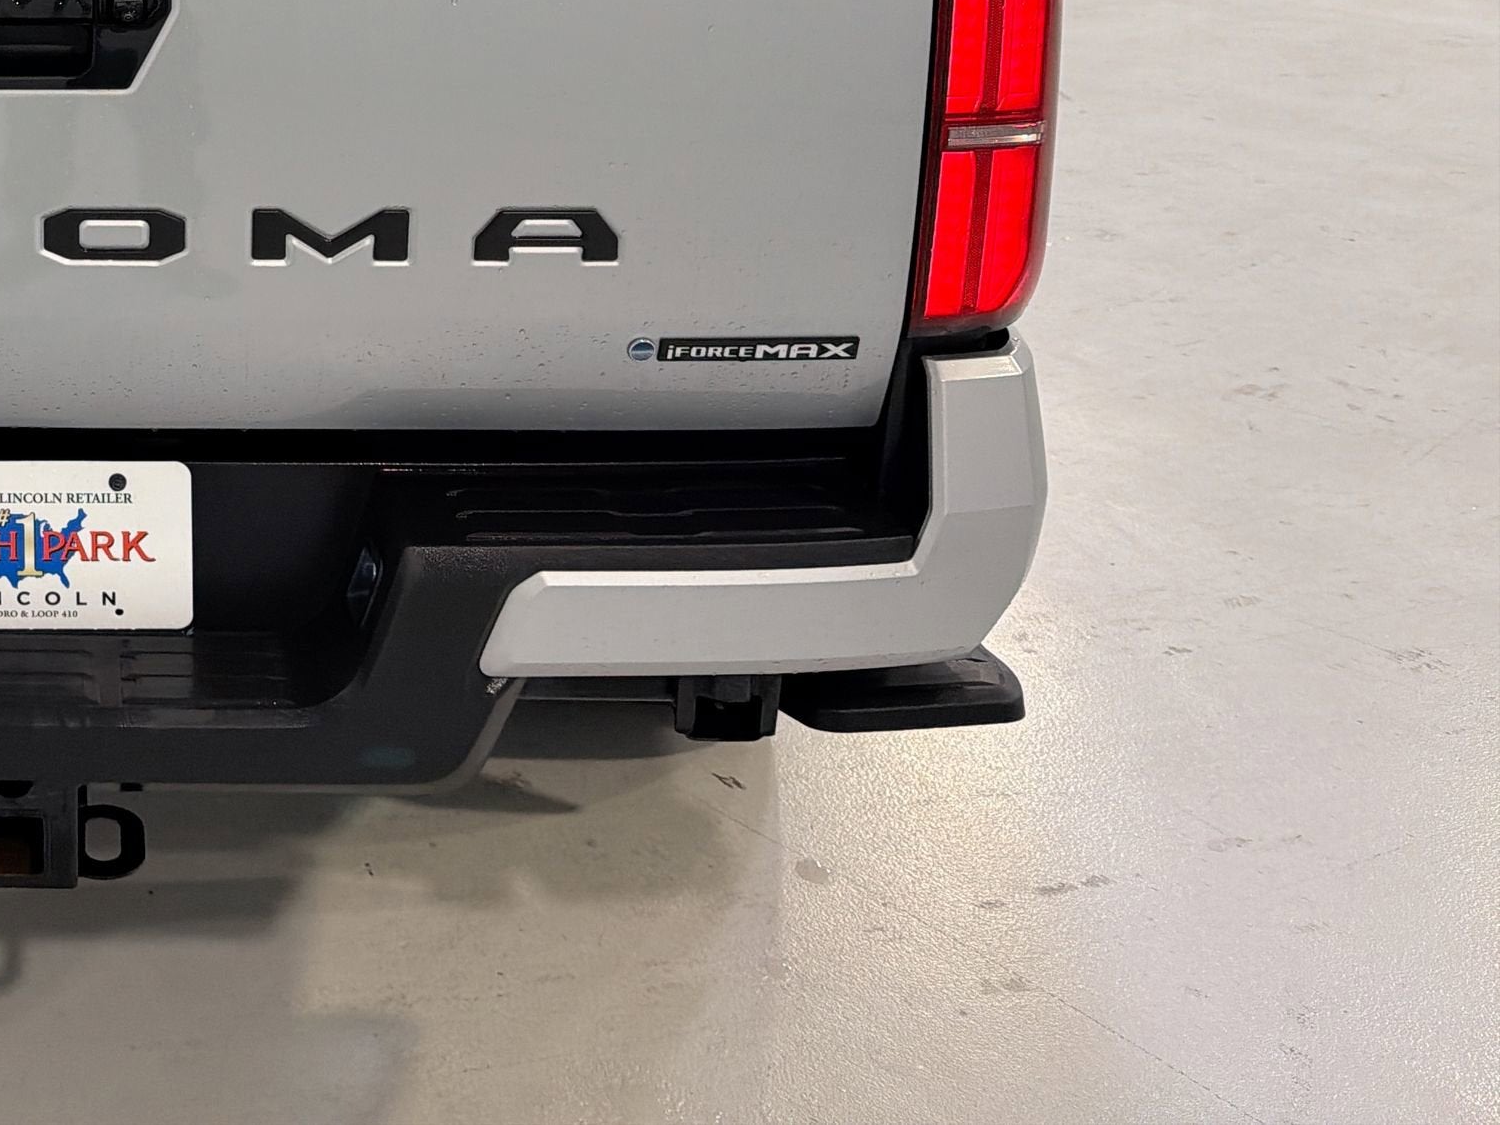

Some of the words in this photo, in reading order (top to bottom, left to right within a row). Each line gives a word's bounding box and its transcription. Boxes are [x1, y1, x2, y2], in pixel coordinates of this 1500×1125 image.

[66, 492, 133, 505] RETAILER
[41, 530, 157, 563] PARK
[20, 609, 29, 618] &
[31, 609, 60, 619] LOOP
[61, 609, 79, 619] 410
